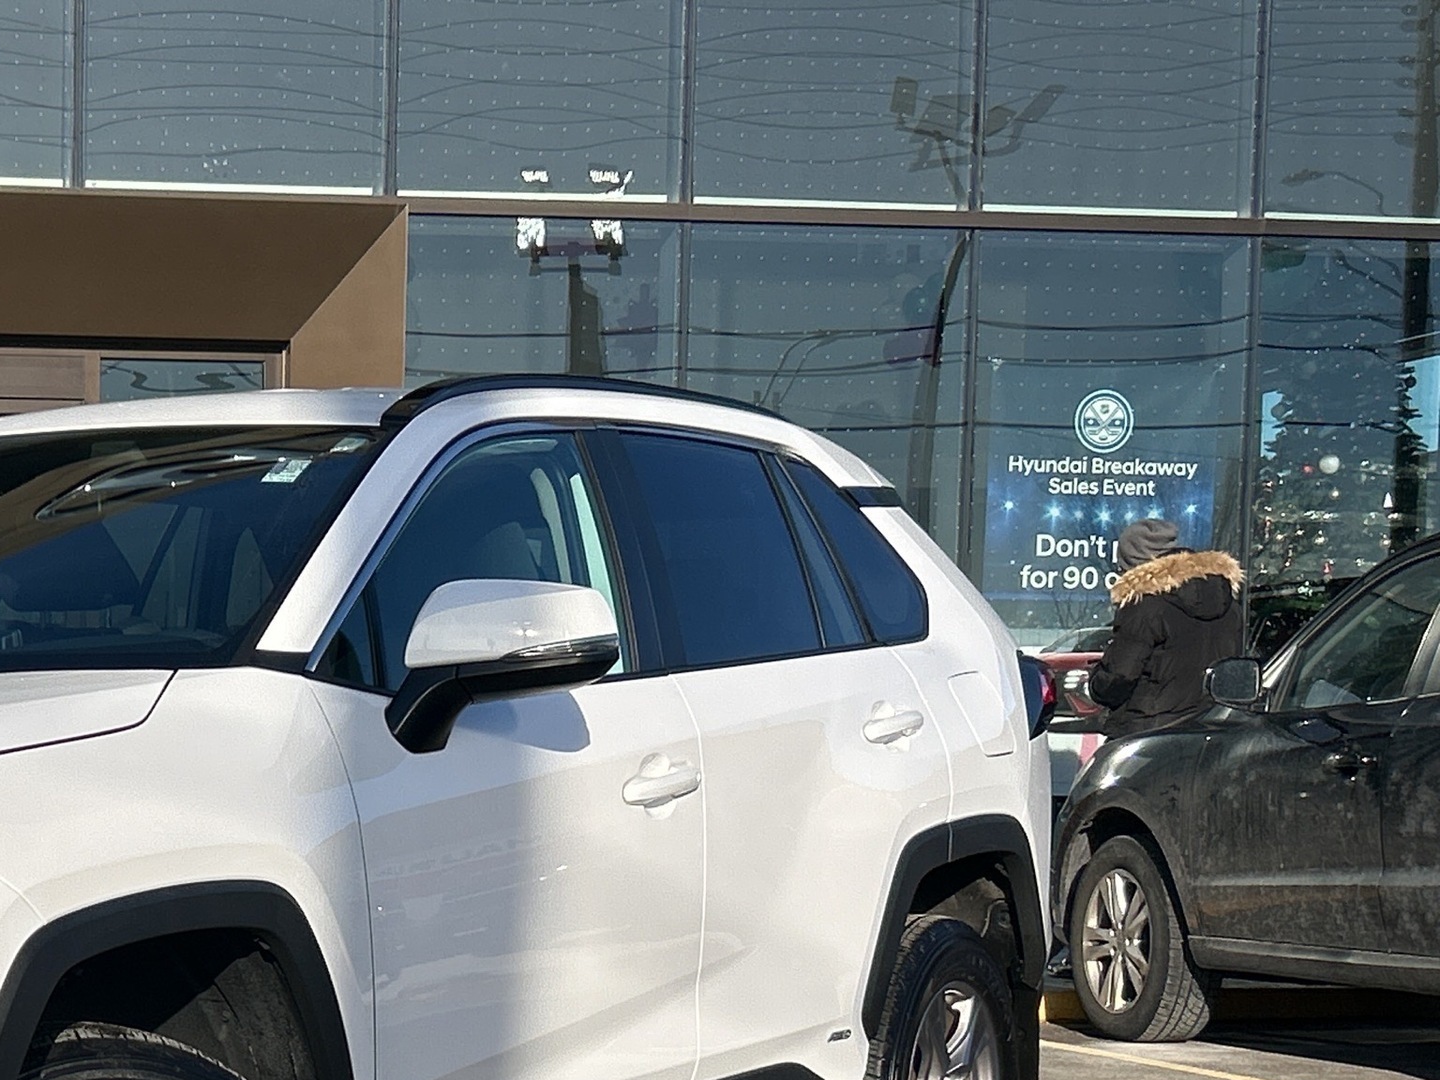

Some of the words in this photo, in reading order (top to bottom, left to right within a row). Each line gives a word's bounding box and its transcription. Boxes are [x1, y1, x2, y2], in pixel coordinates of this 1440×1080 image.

[1008, 455, 1088, 475] Hyundai
[1091, 457, 1198, 480] Breakaway
[1048, 478, 1099, 496] Sales
[1102, 479, 1156, 497] Event
[1036, 533, 1107, 558] Don't
[1020, 564, 1058, 589] for
[1063, 565, 1099, 590] 90
